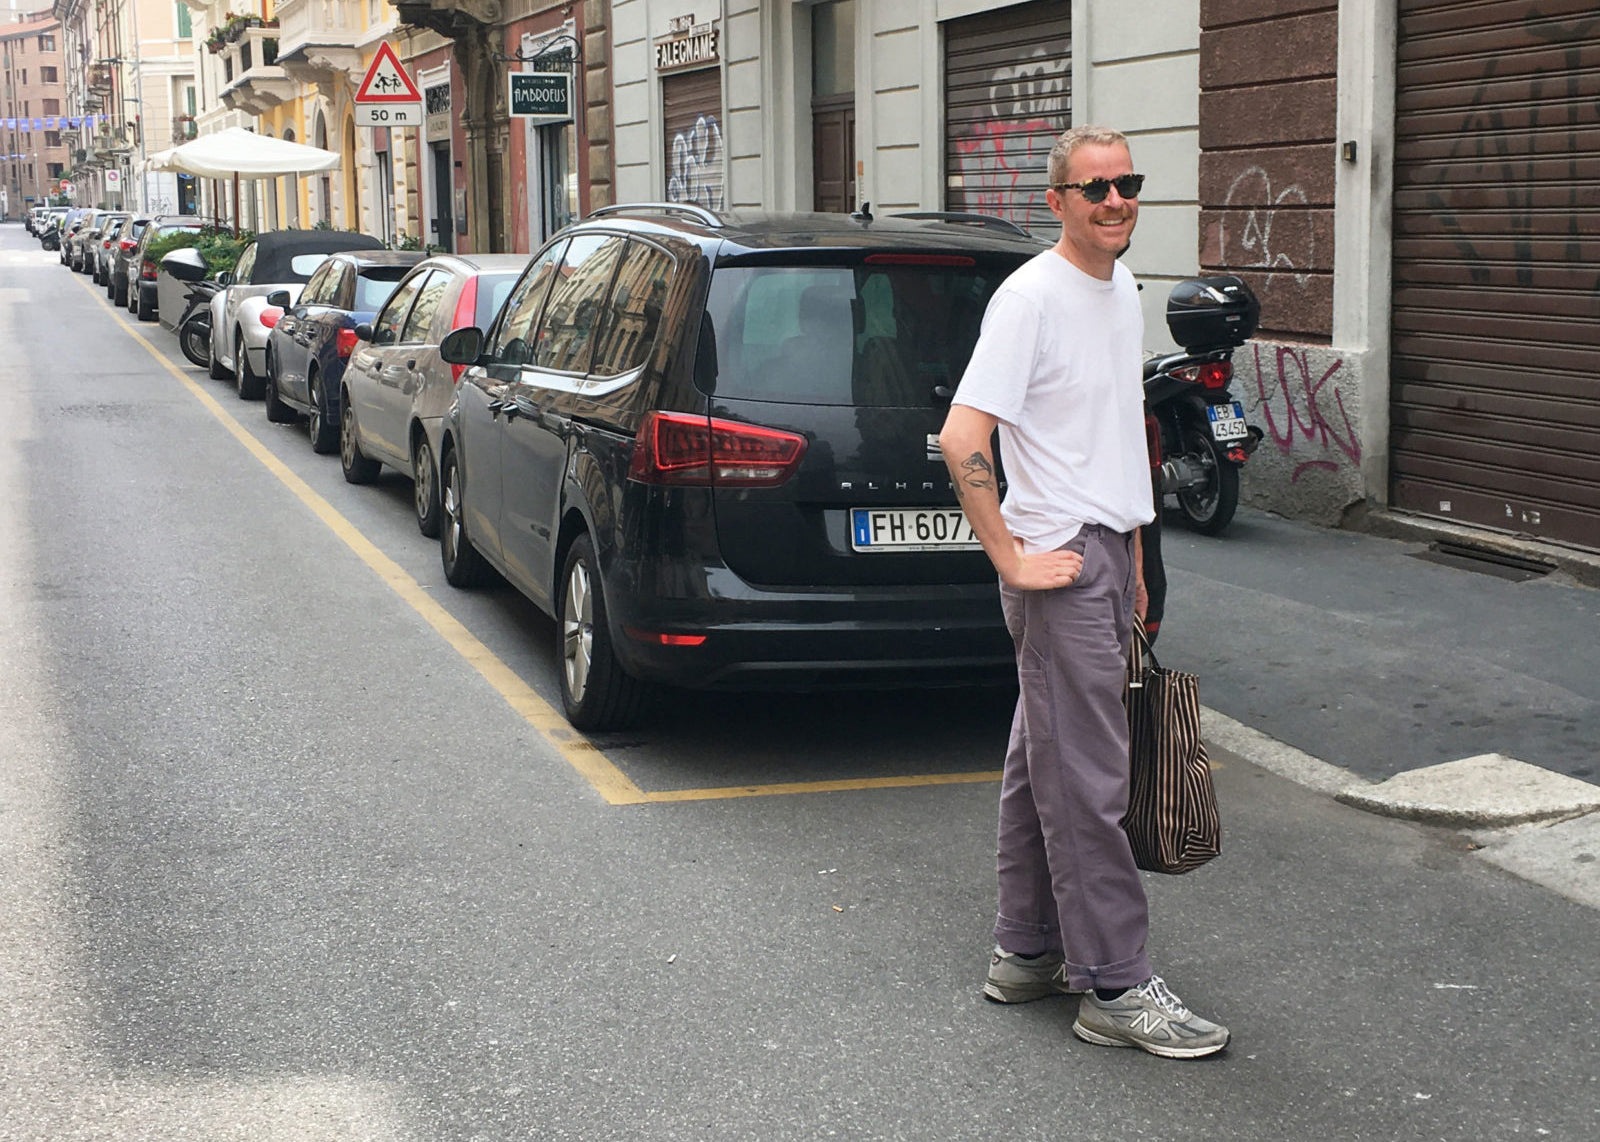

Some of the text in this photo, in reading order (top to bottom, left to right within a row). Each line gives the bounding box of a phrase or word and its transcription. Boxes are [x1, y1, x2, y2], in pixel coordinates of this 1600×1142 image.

[655, 32, 716, 68] FALEGNAME
[513, 87, 566, 103] AMBROEUS
[371, 109, 407, 121] 50 m
[1215, 404, 1230, 420] EB
[1215, 421, 1247, 437] 43452
[872, 513, 906, 542] FH
